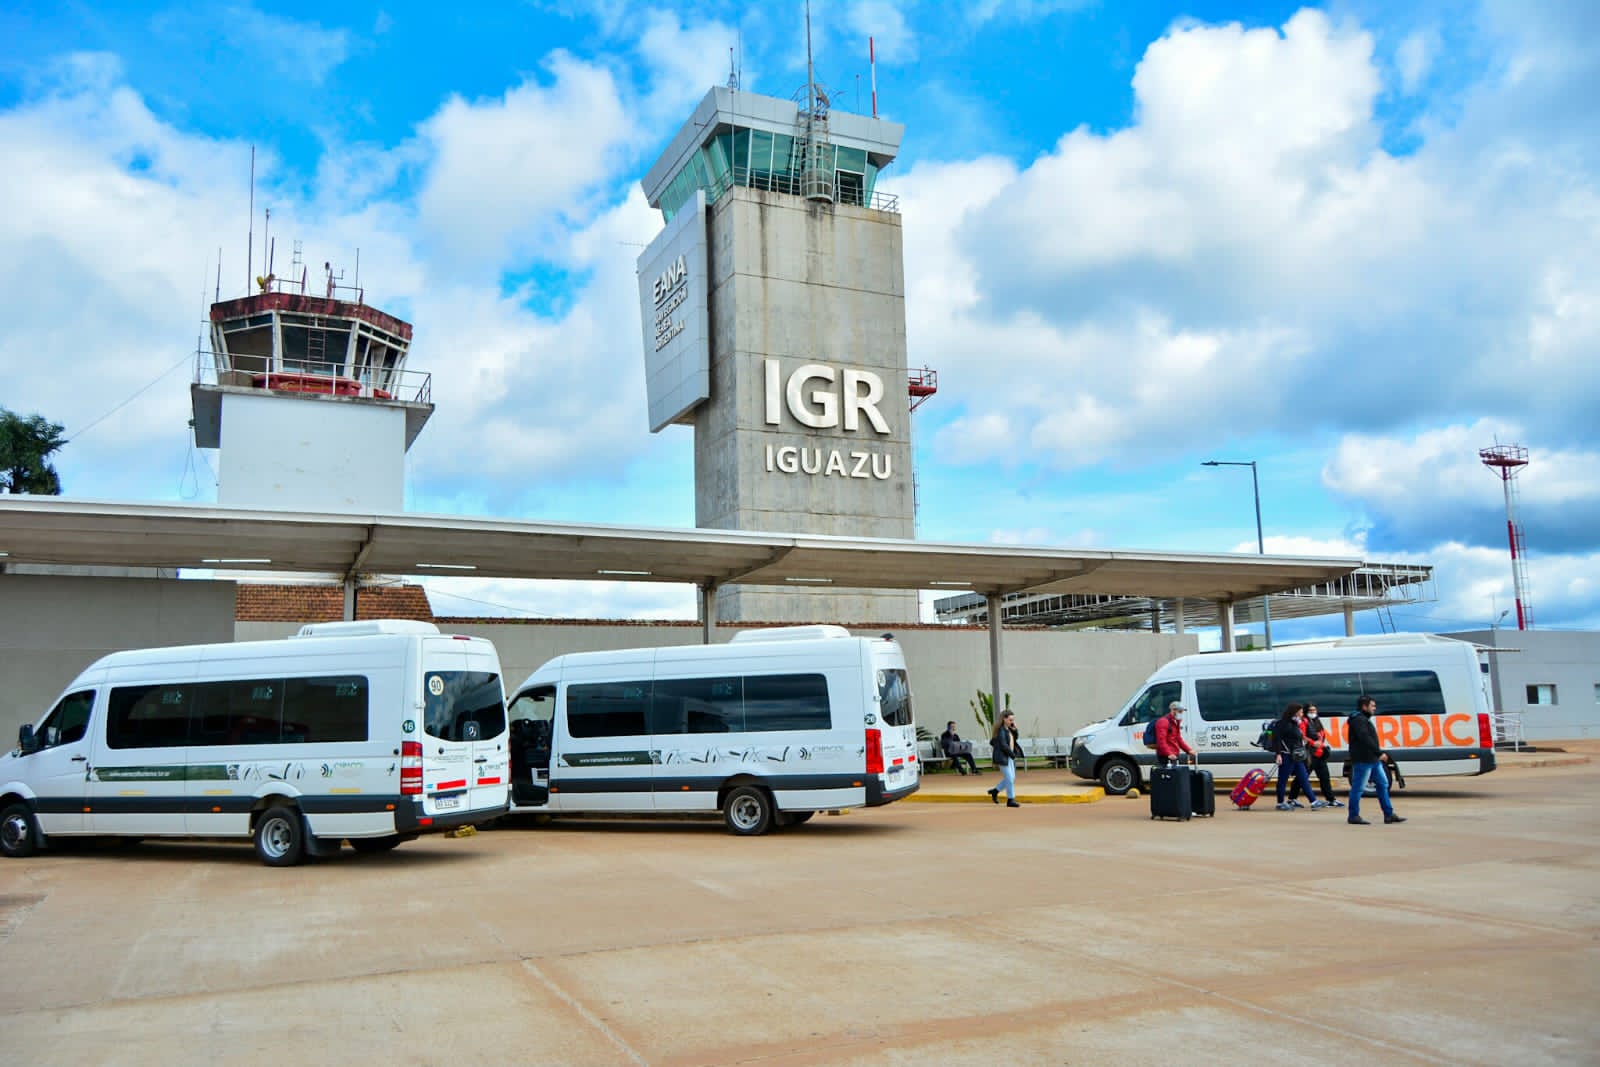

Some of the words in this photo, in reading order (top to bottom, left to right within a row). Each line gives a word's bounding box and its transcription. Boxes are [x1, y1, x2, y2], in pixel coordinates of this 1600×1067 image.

[653, 254, 687, 304] EANA
[764, 359, 891, 435] IGR
[765, 444, 892, 480] IGUAZU
[431, 680, 441, 691] 90
[1324, 713, 1475, 748] NRDIC
